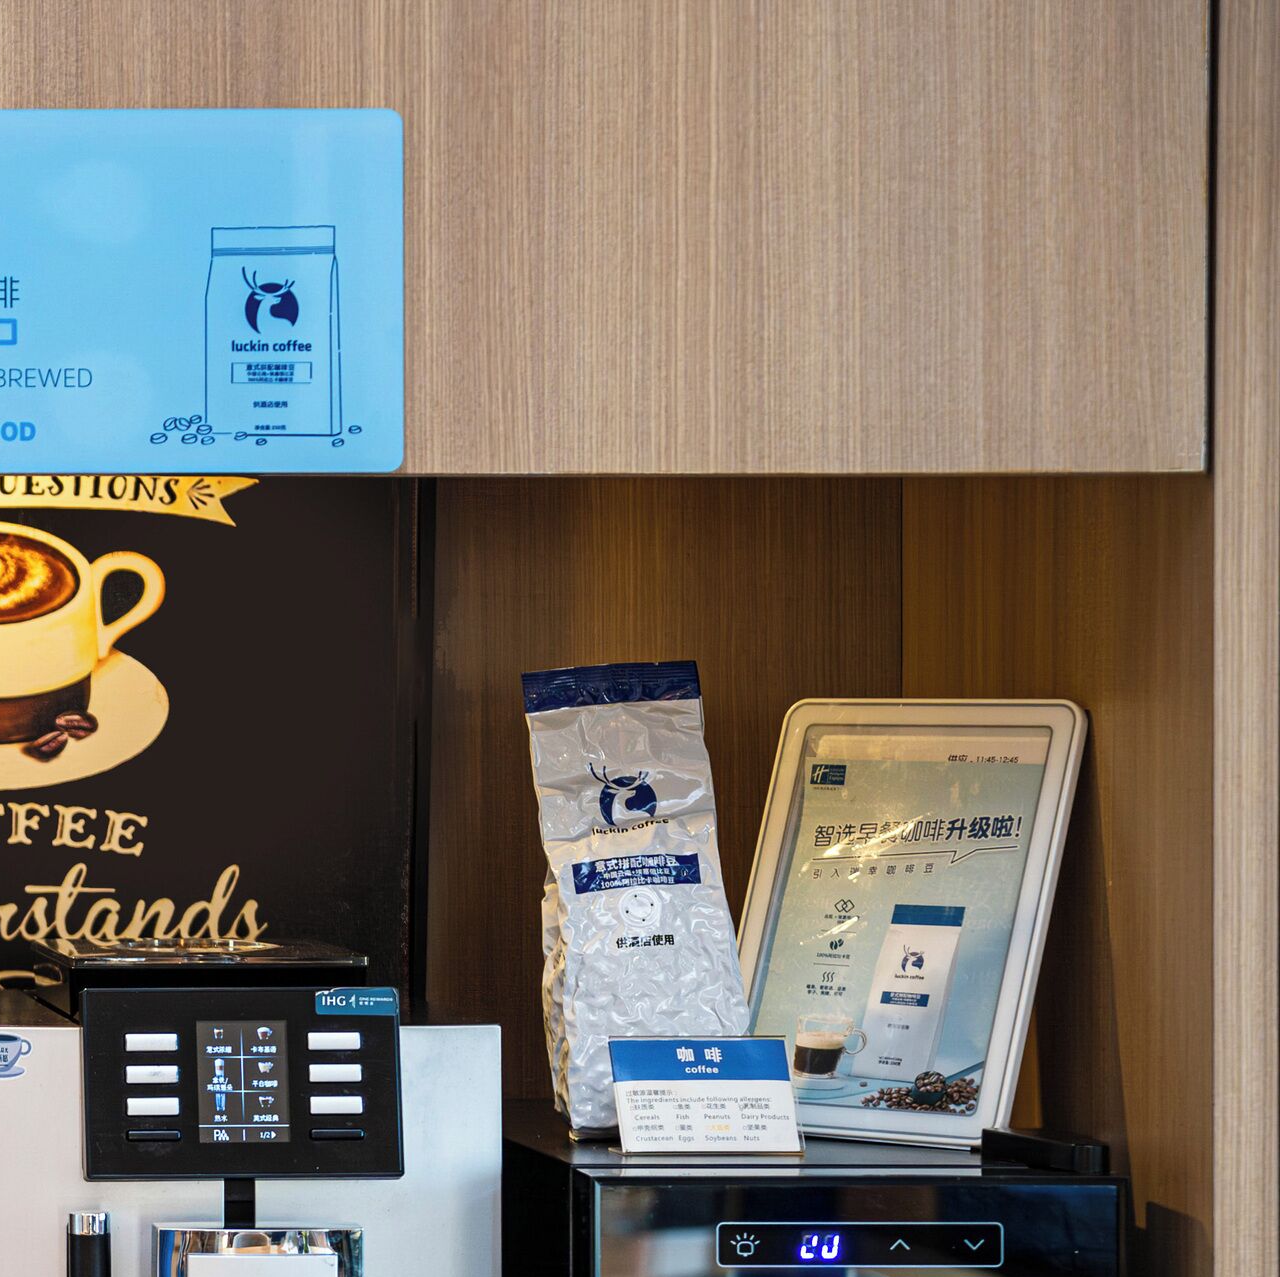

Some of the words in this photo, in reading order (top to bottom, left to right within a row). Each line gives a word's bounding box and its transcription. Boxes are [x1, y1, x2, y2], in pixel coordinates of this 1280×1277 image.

[231, 340, 269, 352] luckin
[273, 340, 312, 352] coffee
[616, 934, 674, 948] 供酒店使用
[322, 996, 346, 1006] IHG
[676, 1046, 723, 1062] 咖啡
[685, 1065, 719, 1074] coffee
